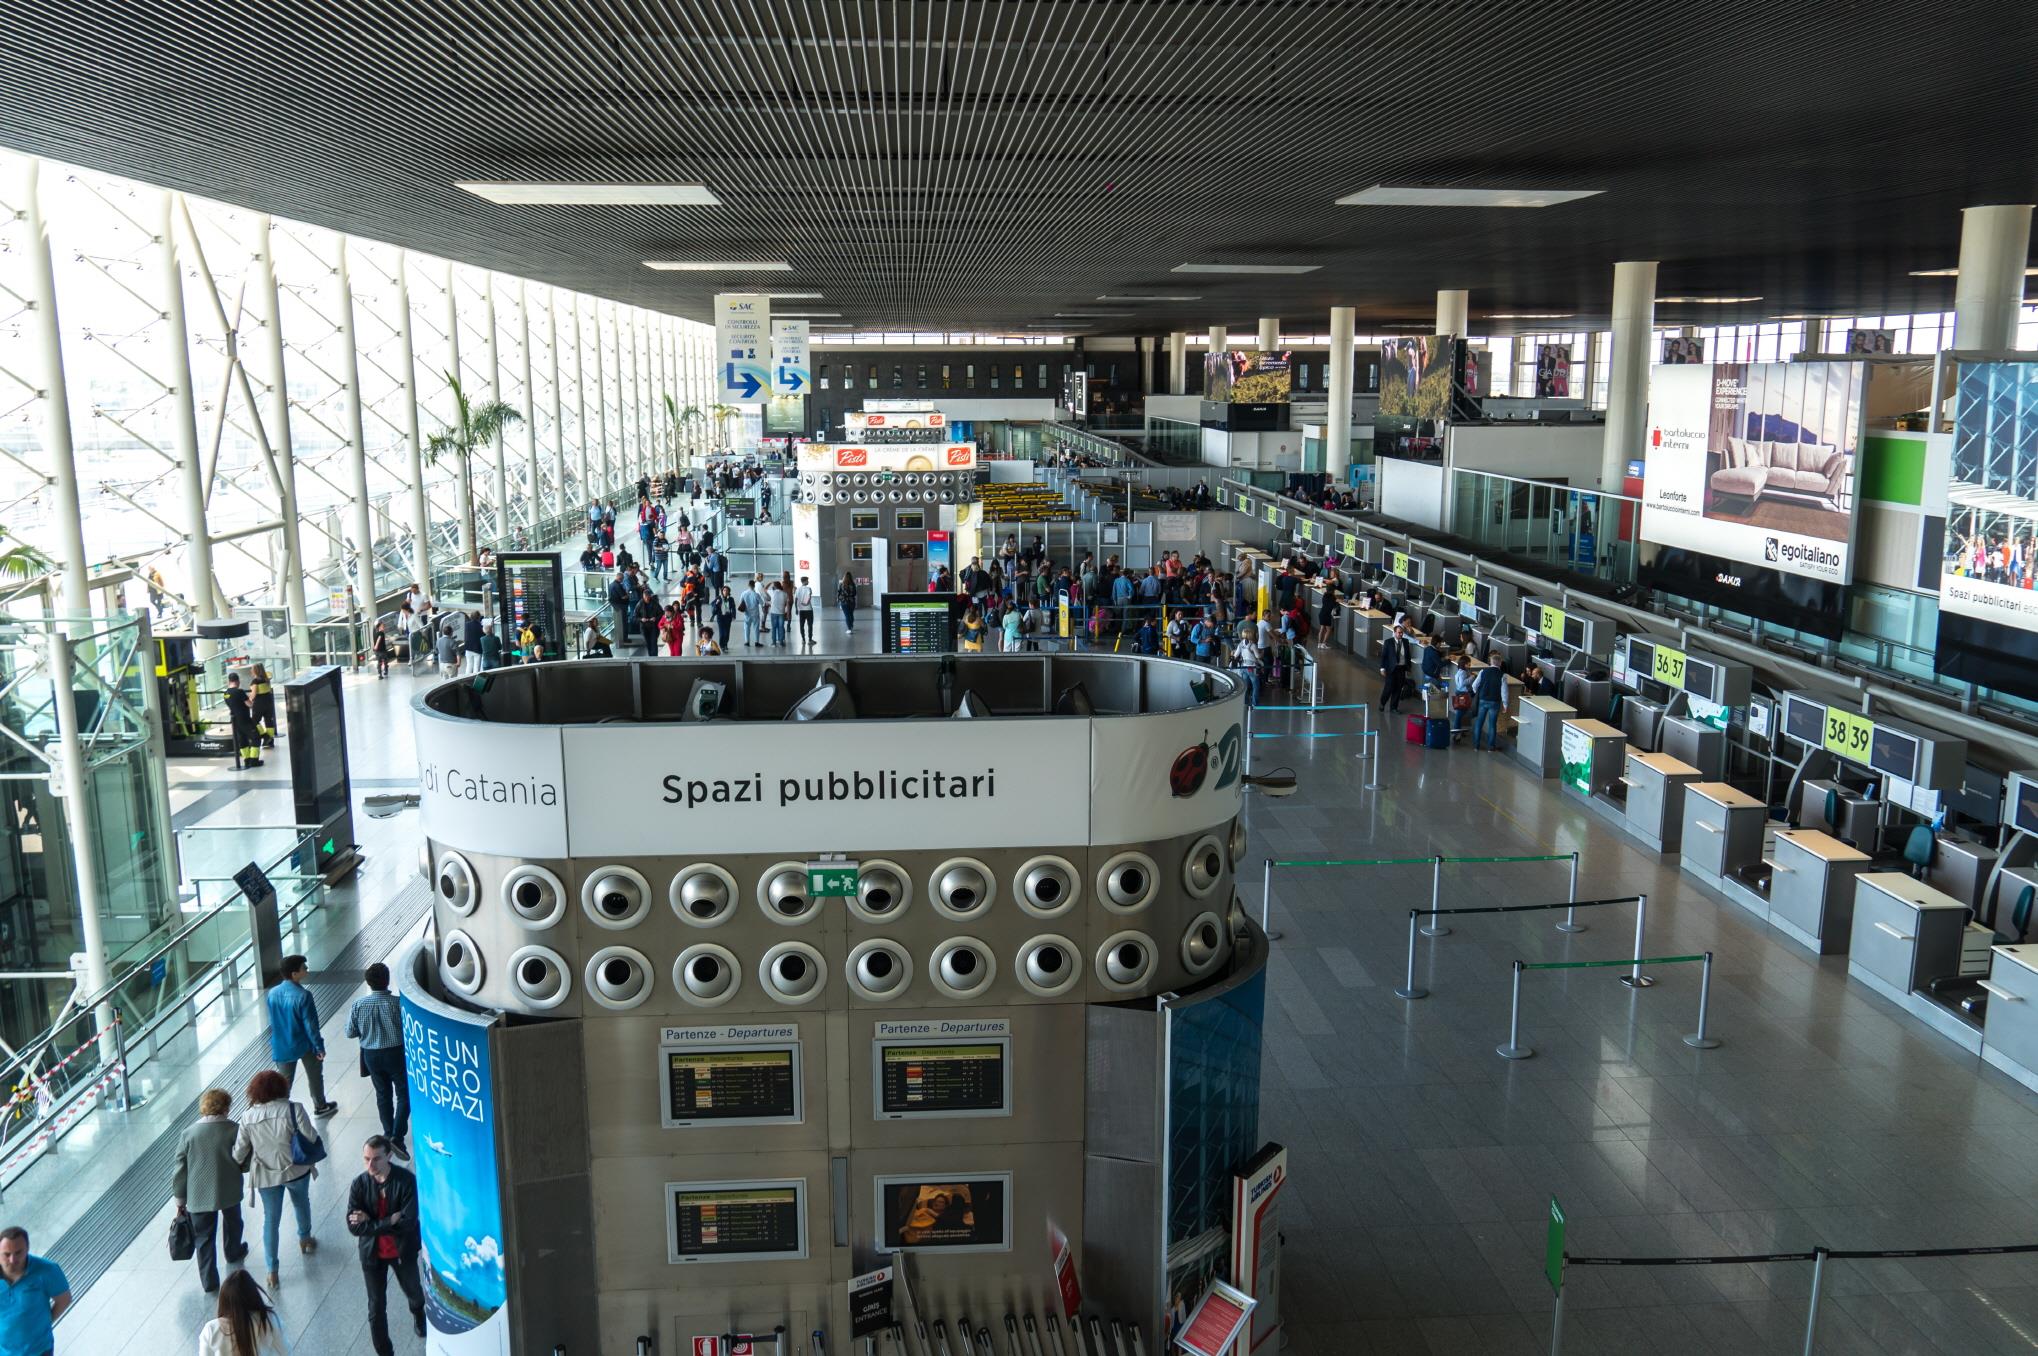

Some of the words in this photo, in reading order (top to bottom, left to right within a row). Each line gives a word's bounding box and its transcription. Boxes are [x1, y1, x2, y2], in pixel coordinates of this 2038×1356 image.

[1659, 489, 1687, 502] Leonforte
[1781, 544, 1840, 567] egoitaliano
[1459, 580, 1467, 597] 33
[1949, 587, 1971, 600] Spazi
[1972, 593, 2021, 612] pubblicitari
[1543, 612, 1553, 630] 35
[1656, 653, 1669, 674] 36
[1671, 659, 1684, 679] 37
[1828, 717, 1846, 744] 38
[1850, 725, 1869, 751] 39
[425, 763, 439, 793] di
[447, 769, 557, 806] Catania
[662, 772, 763, 808] Spazi
[778, 768, 995, 807] pubblicitari
[666, 1029, 717, 1040] Partenze
[727, 1028, 793, 1040] Departures
[880, 1023, 930, 1034] Partenze
[940, 1022, 1005, 1034] Departures
[427, 1028, 442, 1055] E
[444, 1036, 480, 1068] UN
[430, 1080, 485, 1124] SPAZI
